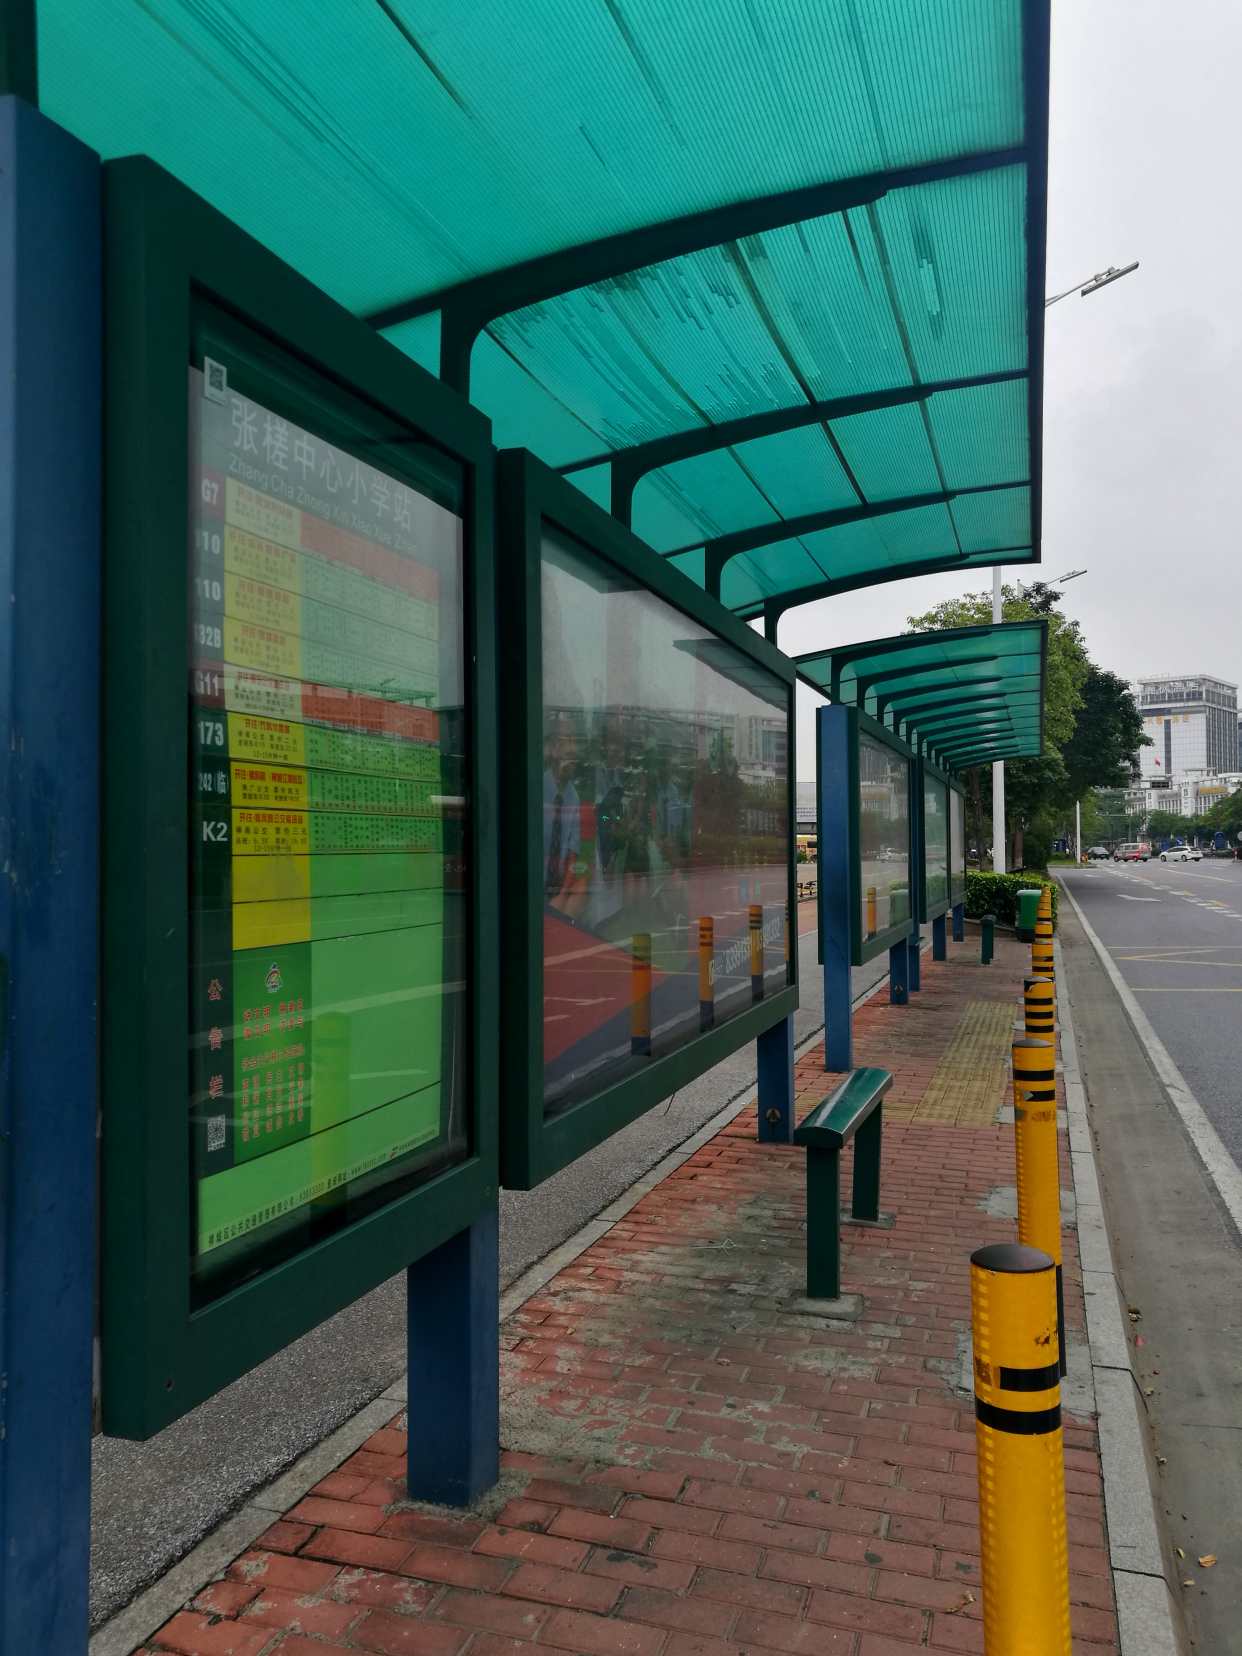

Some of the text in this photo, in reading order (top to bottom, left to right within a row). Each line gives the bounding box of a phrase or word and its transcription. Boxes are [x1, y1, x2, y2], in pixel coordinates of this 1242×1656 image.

[201, 477, 219, 506] G7
[231, 396, 412, 533] 张槎中心小学站
[229, 454, 268, 491] Zhang
[271, 475, 294, 500] Cha
[297, 486, 330, 519] Zhong
[333, 504, 349, 524] Xin
[351, 513, 372, 536] Xiao
[374, 523, 392, 545] Xue
[395, 534, 417, 556] Zhan
[198, 721, 224, 746] 173
[202, 821, 228, 842] K2
[208, 979, 223, 1100] 公告栏
